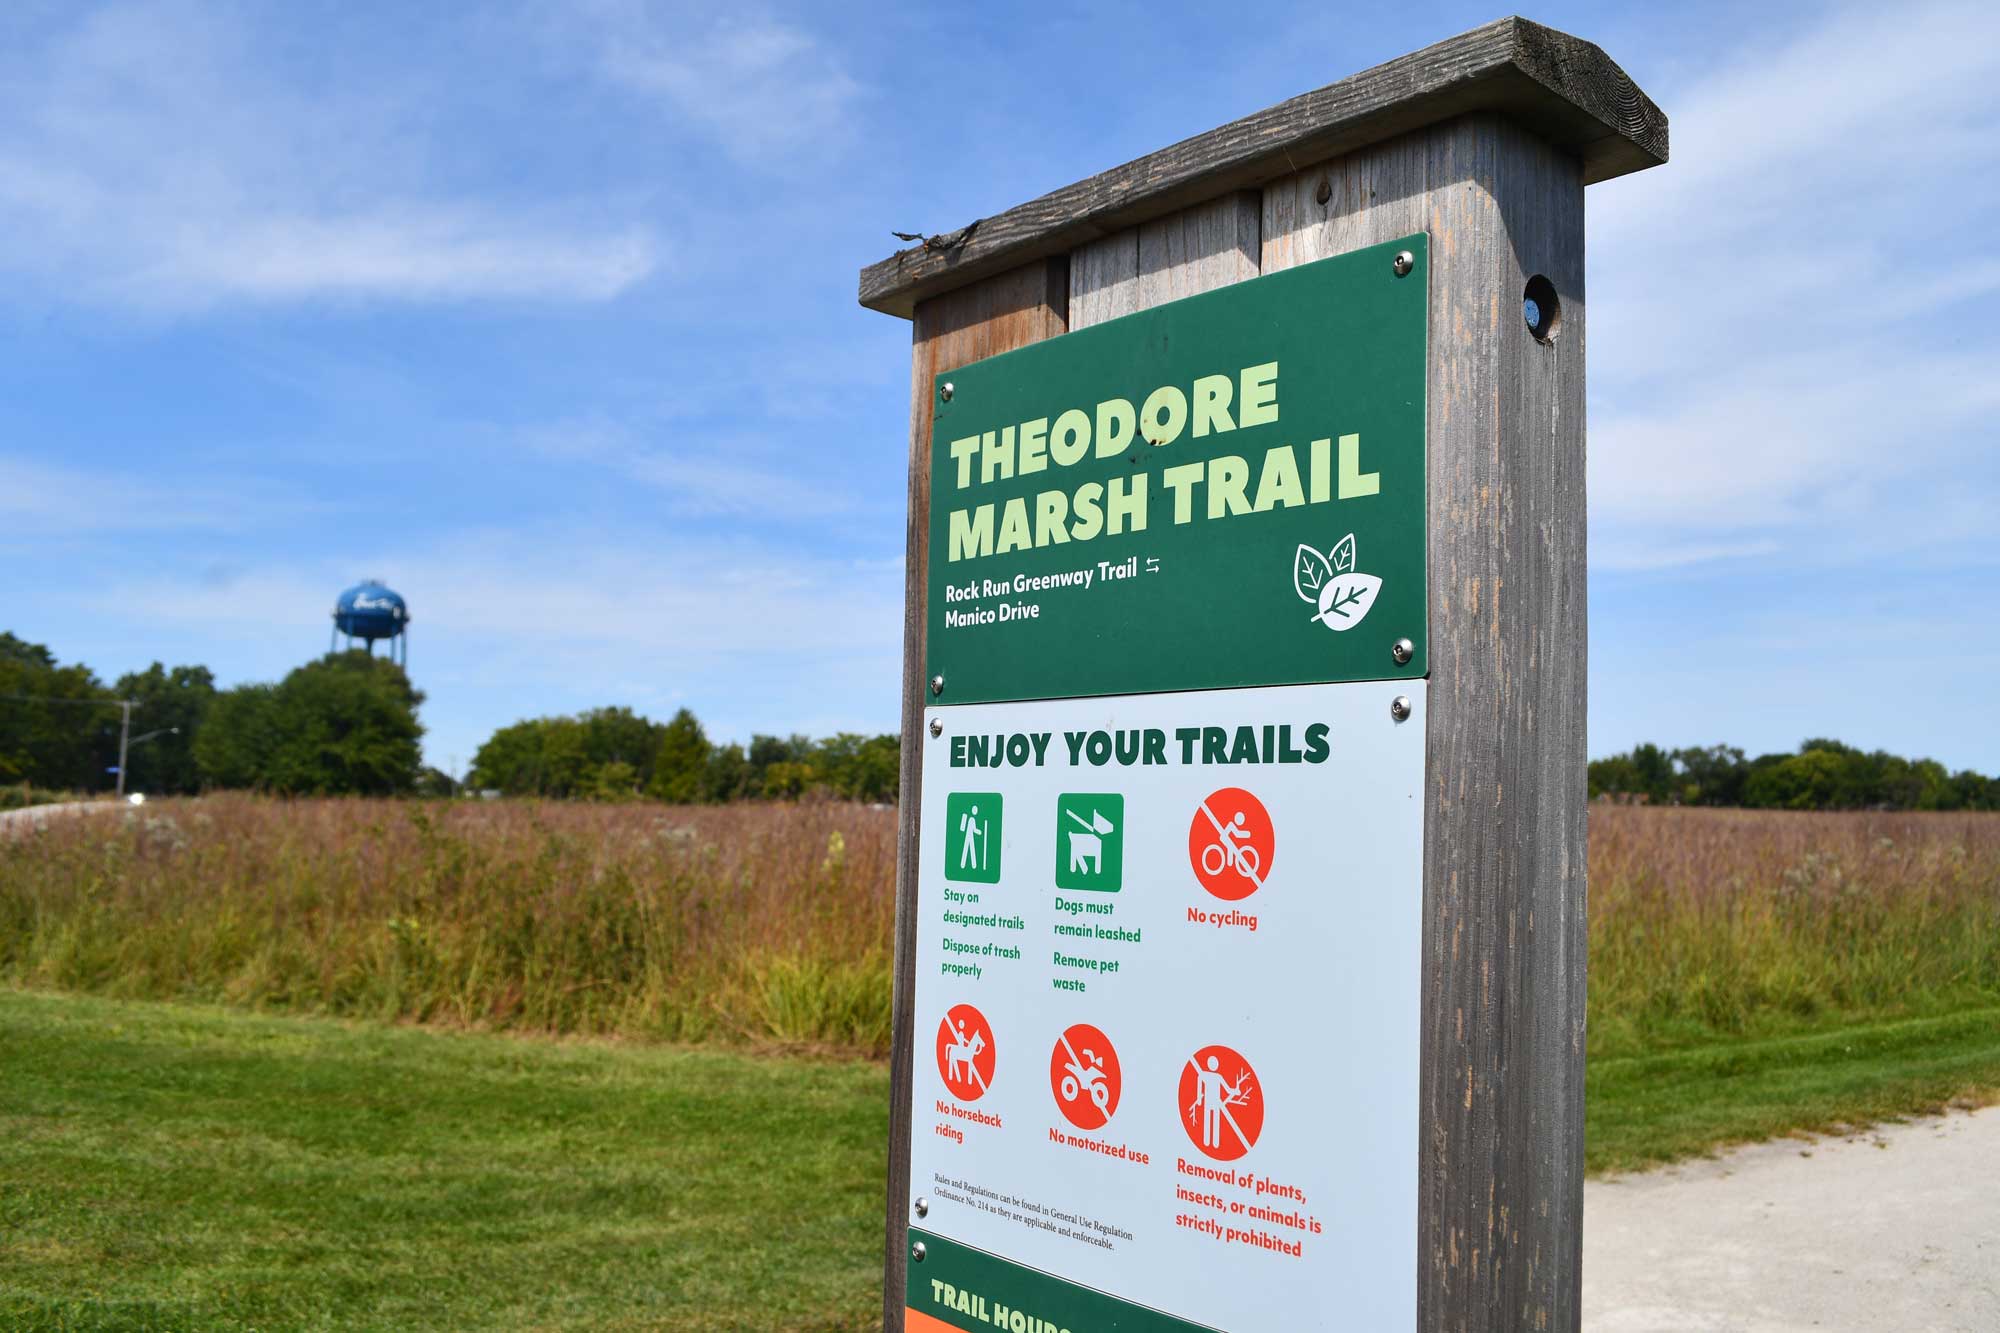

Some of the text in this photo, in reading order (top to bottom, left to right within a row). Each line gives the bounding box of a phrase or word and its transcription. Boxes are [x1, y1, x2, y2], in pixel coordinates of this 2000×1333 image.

[950, 361, 1279, 489] THEODORE
[948, 433, 1380, 562] MARSH TRAIL
[946, 556, 1137, 602] Rock Run Greenway Trail
[945, 601, 1039, 628] Manico Drive
[949, 723, 1330, 768] ENJOY YOUR TRAILS
[944, 888, 979, 905] Stay on
[1055, 897, 1114, 915] Dogs must
[943, 909, 1024, 930] designated trails
[1054, 923, 1141, 943] remain leashed
[1187, 907, 1258, 931] No cycling
[943, 938, 1021, 959] Dispose of trash
[942, 962, 982, 980] properly
[1053, 952, 1119, 974] Remove pet
[1053, 977, 1086, 992] waste
[936, 1100, 1002, 1128] No horseback
[935, 1123, 963, 1144] riding
[1049, 1127, 1149, 1165] No motorized use
[1177, 1158, 1306, 1204] Removal of plants,
[934, 1173, 1133, 1241] Rules and Regulations can be found in General Use Regulation
[934, 1187, 1115, 1251] Ordinance No. 214 as they are applicable and enforceable.
[1176, 1184, 1322, 1234] insects, or animals is
[1176, 1214, 1302, 1257] strictly prohibited
[931, 1278, 990, 1323] TRAIL
